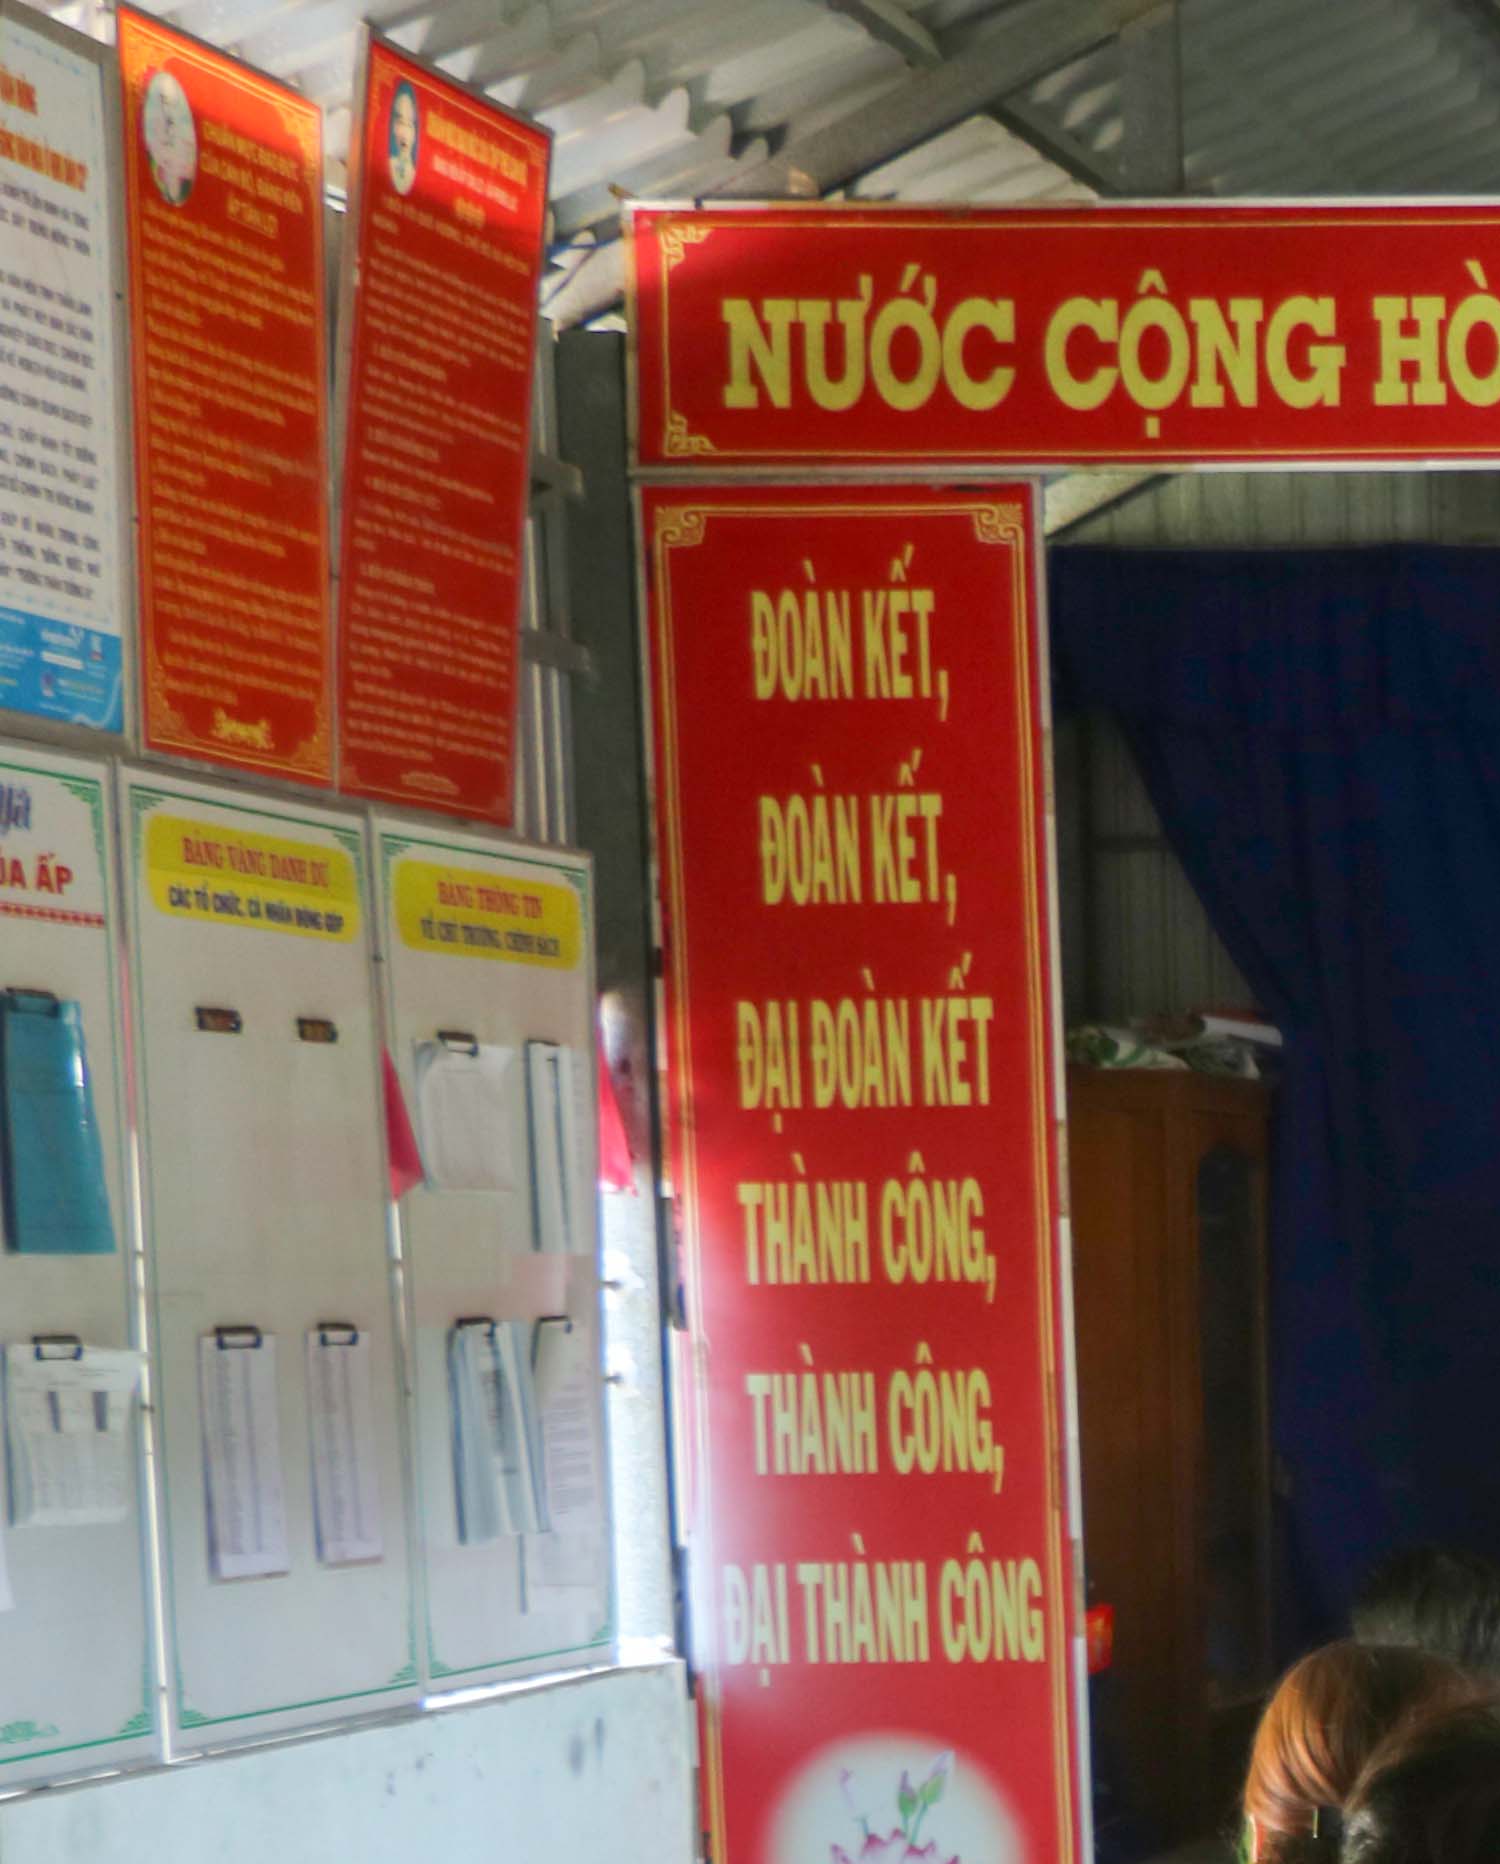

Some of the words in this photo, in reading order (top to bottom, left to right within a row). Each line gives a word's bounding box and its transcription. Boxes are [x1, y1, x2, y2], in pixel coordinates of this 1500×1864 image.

[721, 264, 1015, 411] NƯỚC
[1044, 268, 1346, 438] CỘNG
[752, 558, 853, 701] ĐOÀN
[864, 544, 948, 721] KẾT,
[36, 852, 72, 894] ẤP
[759, 764, 861, 906] ĐOÀN
[871, 749, 957, 925] KẾT,
[738, 1000, 800, 1134] ĐẠI
[812, 966, 911, 1108] ĐOÀN
[922, 952, 992, 1107] KẾT
[738, 1153, 870, 1283] THÀNH
[882, 1152, 996, 1303] CÔNG,
[746, 1344, 877, 1475] THÀNH
[889, 1342, 1003, 1494] CÔNG,
[724, 1559, 789, 1686] ĐẠI
[797, 1533, 929, 1664] THÀNH
[939, 1532, 1044, 1664] CÔNG
